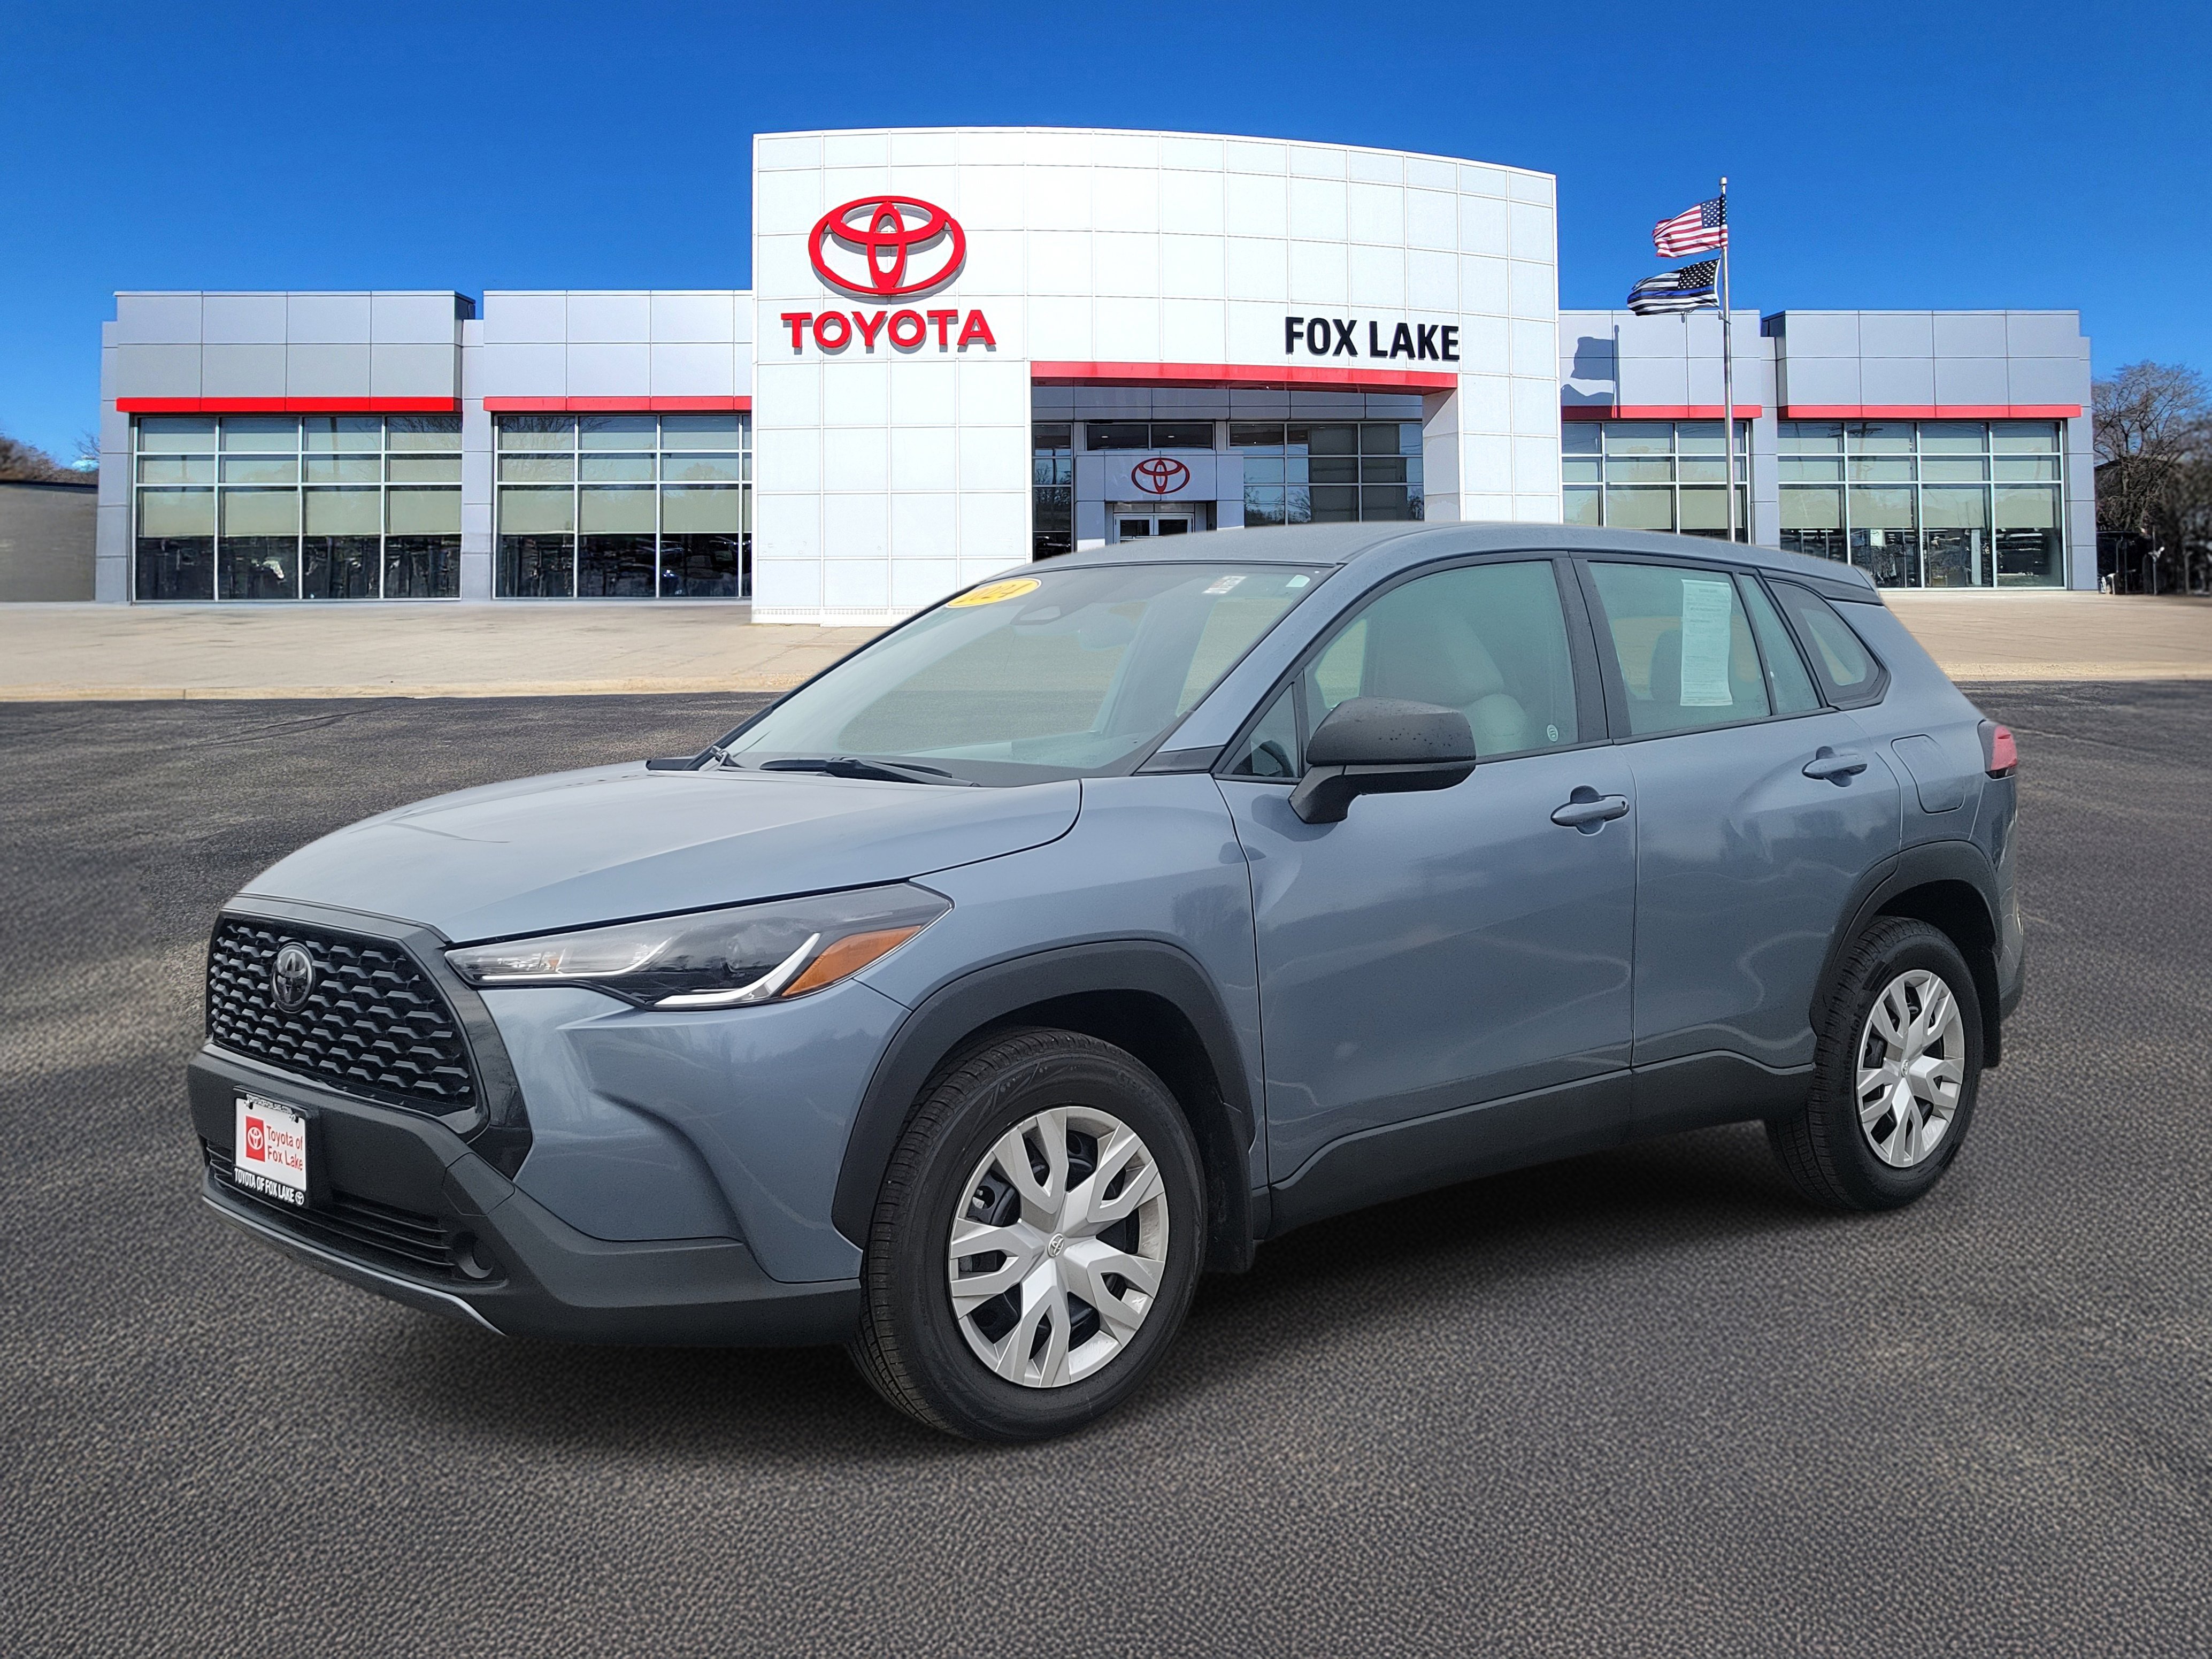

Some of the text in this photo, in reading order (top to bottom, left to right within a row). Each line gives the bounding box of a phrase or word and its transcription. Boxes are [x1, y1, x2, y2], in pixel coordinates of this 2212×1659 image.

[781, 310, 996, 350] TOYOTA
[1285, 317, 1460, 360] FOX LAKE
[266, 1125, 303, 1150] Toyota of
[267, 1145, 303, 1171] Fox Lake
[234, 1168, 295, 1203] TOYOTA OF FOX LAKE
